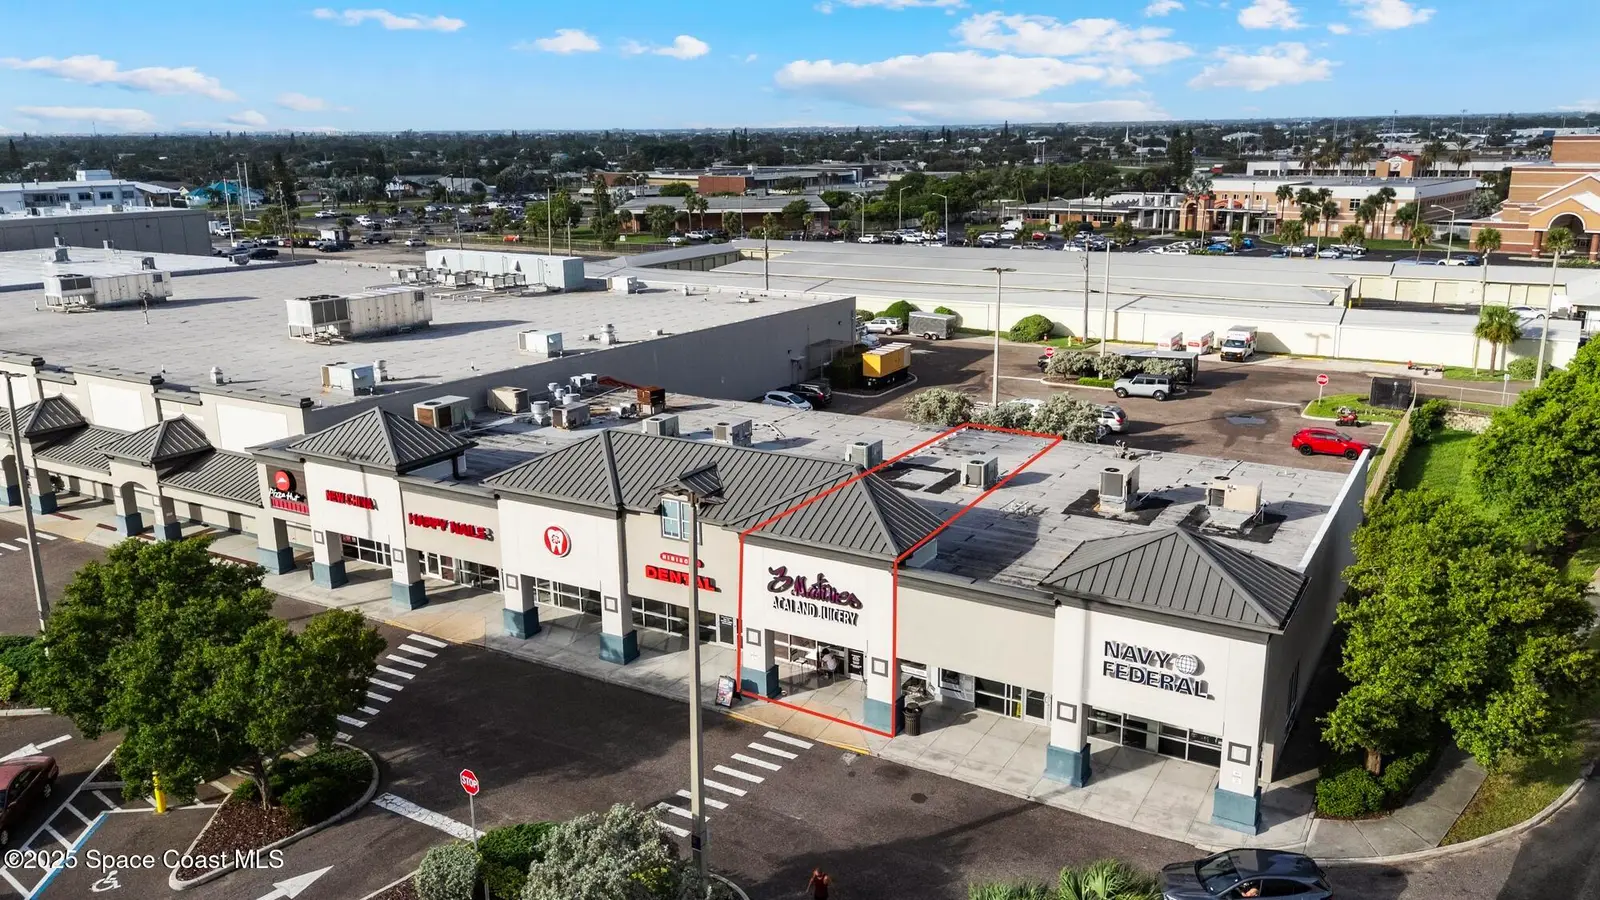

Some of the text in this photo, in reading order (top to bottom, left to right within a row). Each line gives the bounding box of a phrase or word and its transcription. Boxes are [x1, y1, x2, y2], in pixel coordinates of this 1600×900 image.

[269, 487, 301, 502] Pizza Hut
[326, 490, 375, 510] NEW CHINA
[408, 512, 487, 540] HAPPY NAILS
[797, 601, 818, 618] AND
[819, 605, 858, 626] JUICERY
[1104, 640, 1170, 669] NAVY
[1103, 660, 1207, 698] FEDERAL
[461, 775, 478, 789] STOP
